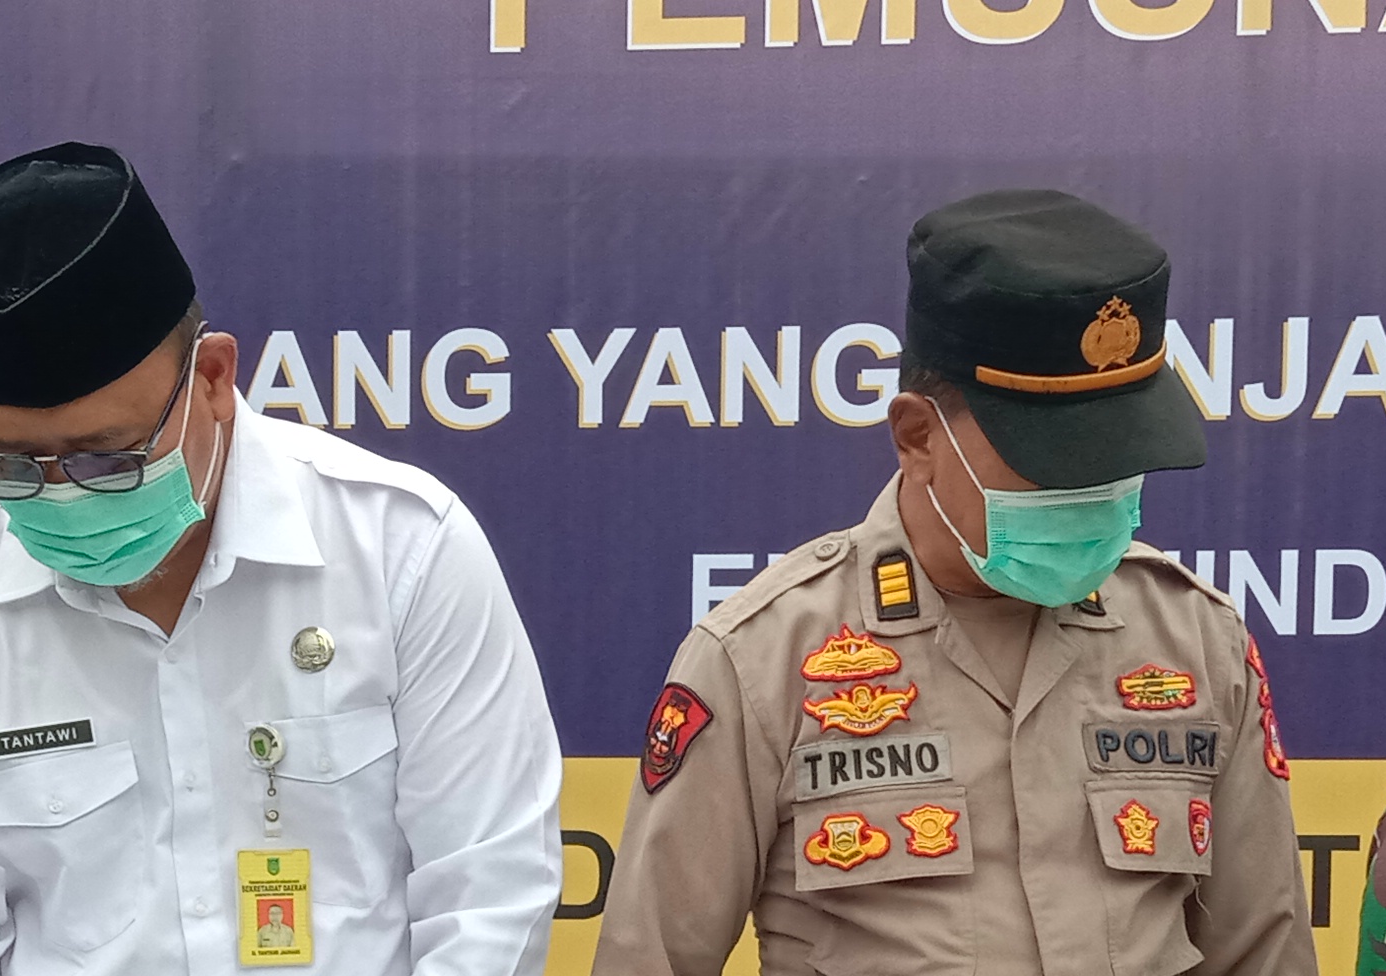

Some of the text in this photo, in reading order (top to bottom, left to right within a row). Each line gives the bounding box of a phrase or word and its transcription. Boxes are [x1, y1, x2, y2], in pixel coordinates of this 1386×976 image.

[547, 323, 901, 428] YANG
[0, 727, 78, 750] TANTAWI
[1095, 728, 1217, 768] POLRI
[804, 742, 939, 791] TRISNO
